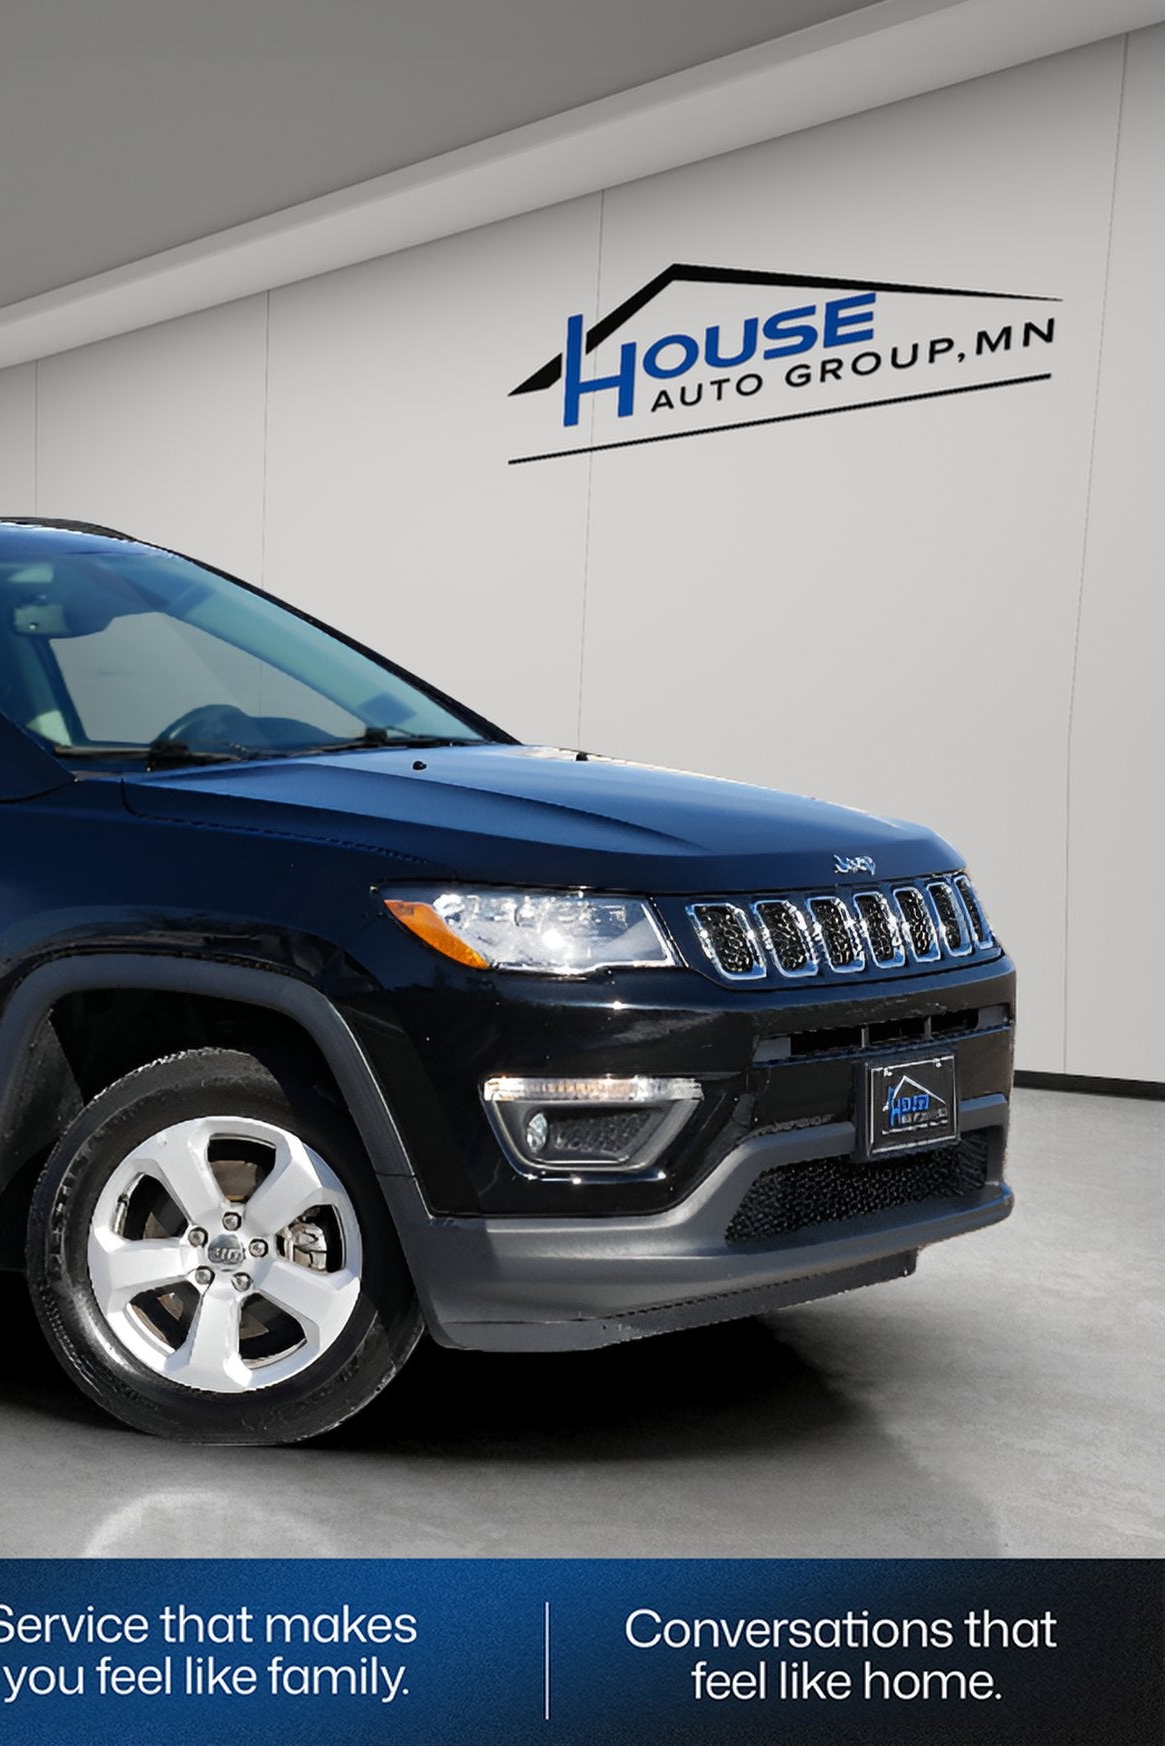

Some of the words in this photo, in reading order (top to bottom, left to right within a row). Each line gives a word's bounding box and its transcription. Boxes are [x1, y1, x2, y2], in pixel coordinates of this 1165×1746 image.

[563, 292, 877, 427] HOUSE
[649, 372, 764, 413] AUTO
[784, 317, 1056, 387] GROUP,MN
